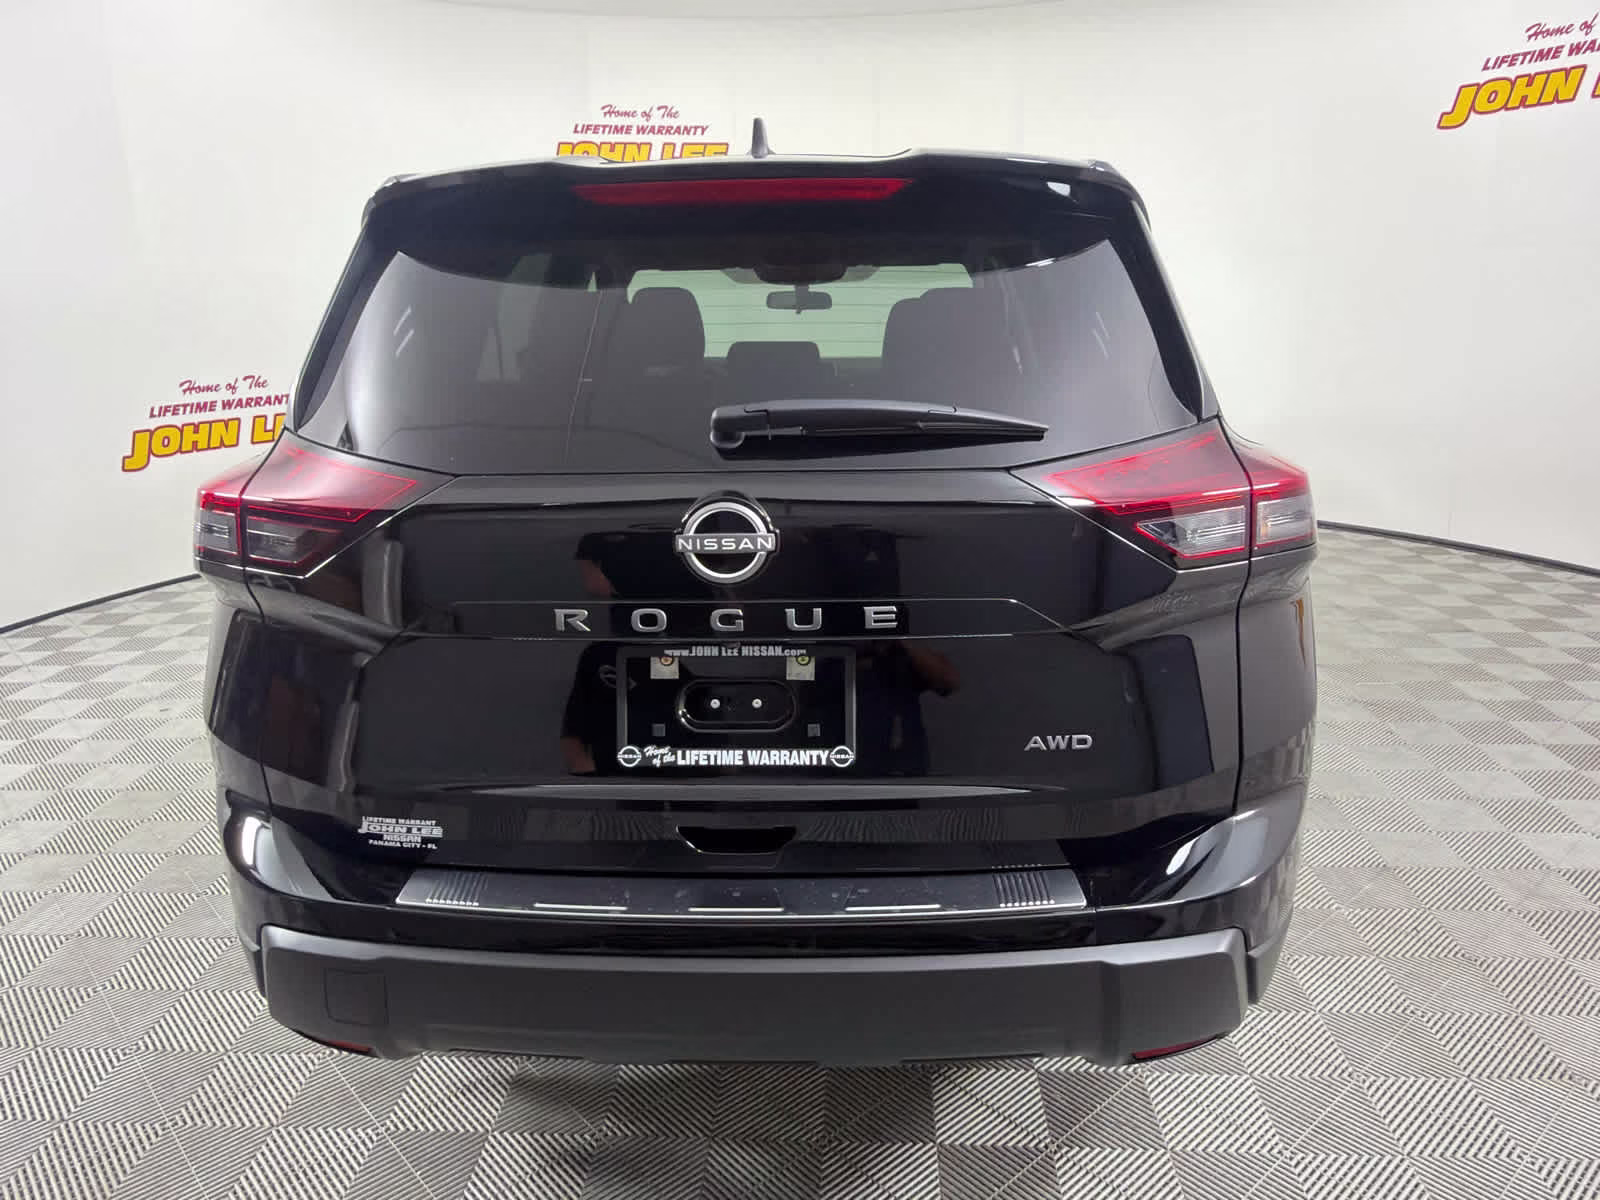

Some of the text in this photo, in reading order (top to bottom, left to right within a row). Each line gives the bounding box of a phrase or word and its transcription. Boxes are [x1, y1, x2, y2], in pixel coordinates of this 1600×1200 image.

[1525, 12, 1599, 42] Home of
[1482, 44, 1565, 72] LIFETIME
[1436, 64, 1588, 130] JOHN
[601, 104, 679, 123] Home of The
[573, 123, 709, 136] LIFETIME WARRANTY
[179, 375, 269, 395] Home of The
[149, 400, 217, 418] LIFETIME
[122, 418, 241, 472] JOHN
[678, 536, 773, 551] NISSAN
[553, 605, 898, 632] ROGUE
[1024, 734, 1093, 751] AWD
[676, 749, 829, 766] LIFETIME WARRANTY
[358, 821, 443, 838] JOHN LEE
